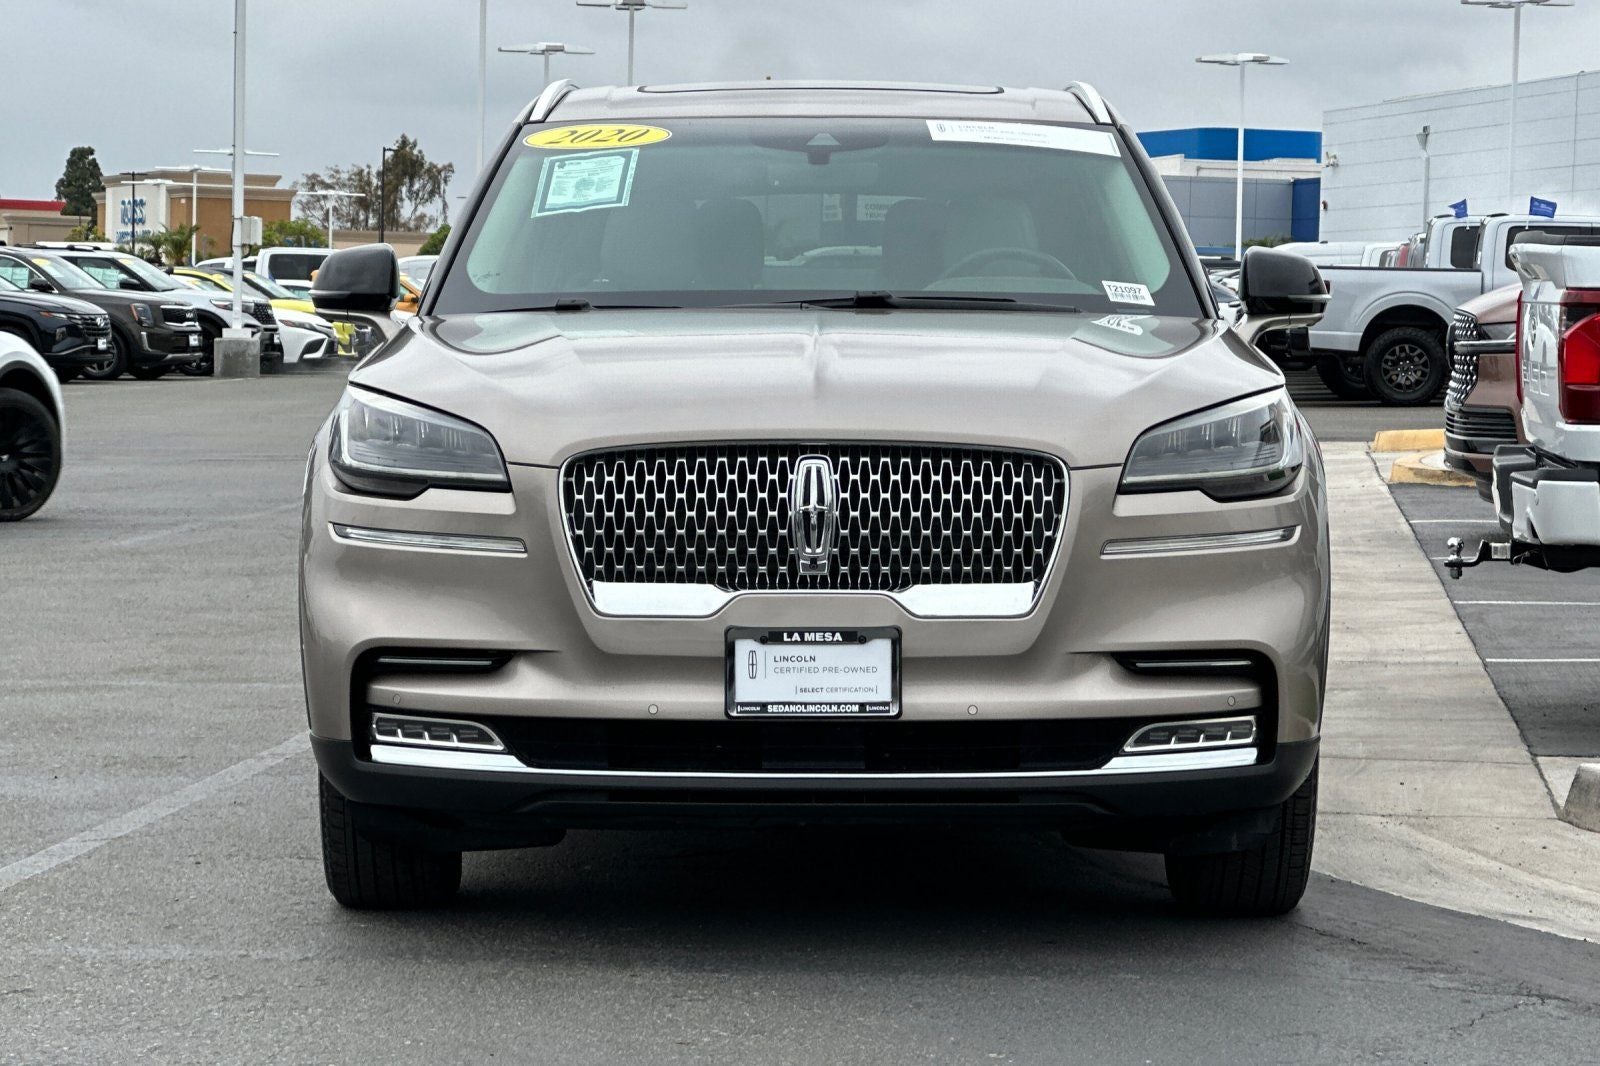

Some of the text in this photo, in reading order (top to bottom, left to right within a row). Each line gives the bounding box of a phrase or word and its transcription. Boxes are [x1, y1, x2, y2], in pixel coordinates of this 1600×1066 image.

[544, 129, 650, 145] 2020
[1105, 284, 1142, 294] T21097
[783, 632, 843, 642] LA MESA
[773, 655, 816, 663] LINCOLN
[773, 666, 878, 674] CERTIFIED PRE-OWNED
[767, 704, 860, 713] SEDANOLINCOLN.COM
